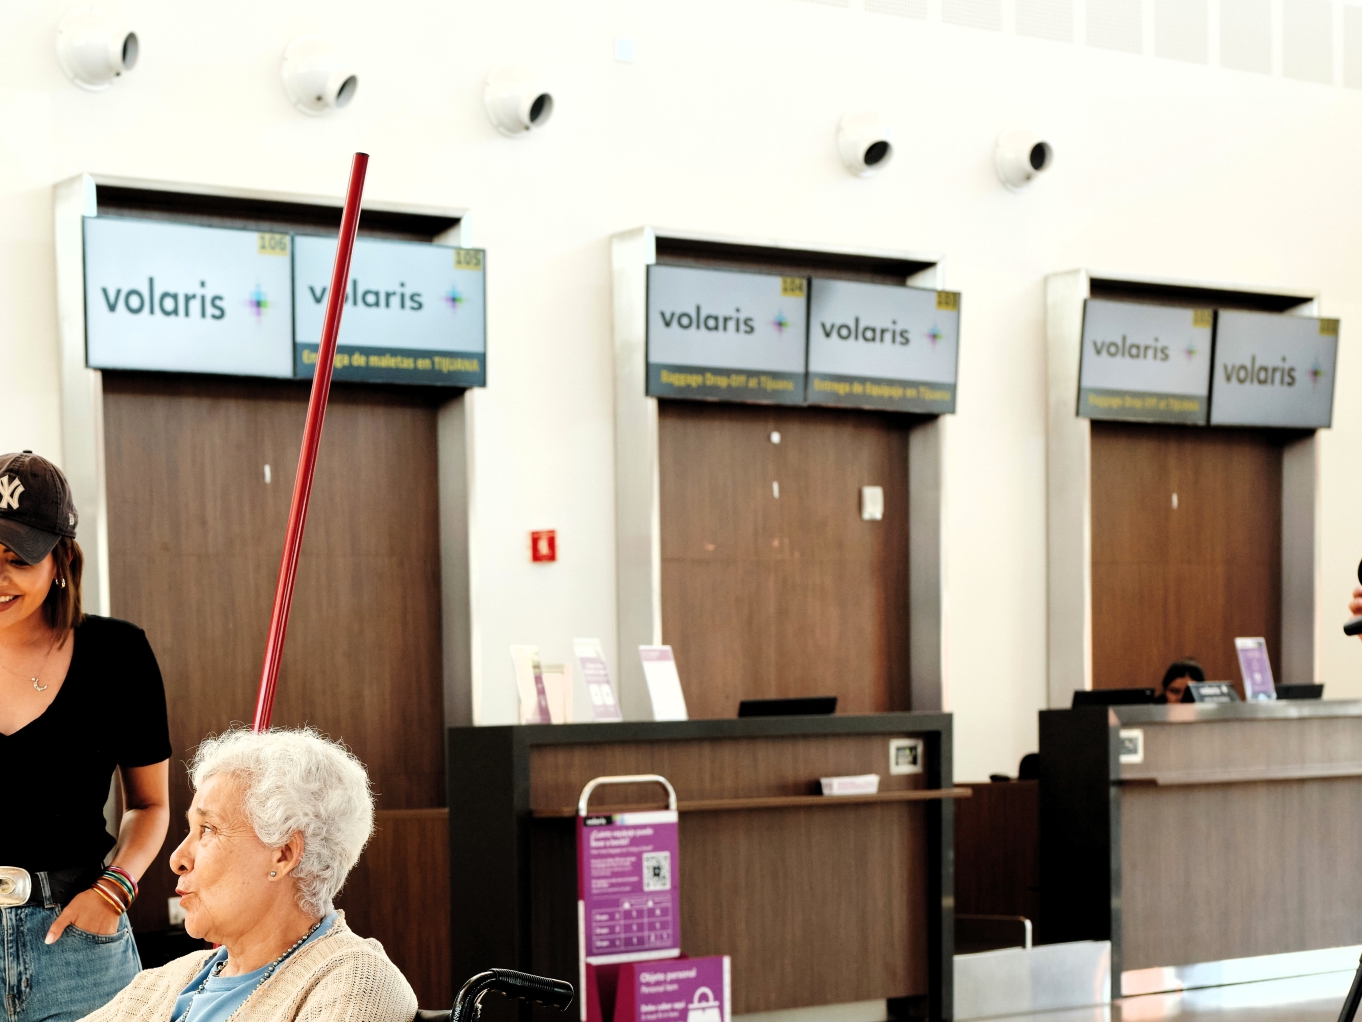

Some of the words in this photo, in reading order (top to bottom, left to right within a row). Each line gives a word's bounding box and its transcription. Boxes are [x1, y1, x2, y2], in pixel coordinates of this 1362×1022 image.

[259, 236, 287, 252] 106
[455, 250, 481, 267] 105
[101, 276, 226, 320] volaris
[660, 305, 755, 334] volaris
[821, 317, 910, 346] volaris
[351, 352, 366, 367] de
[369, 353, 415, 370] maletas
[417, 357, 432, 370] en
[1093, 335, 1170, 362] volaris
[1223, 355, 1296, 387] volaris
